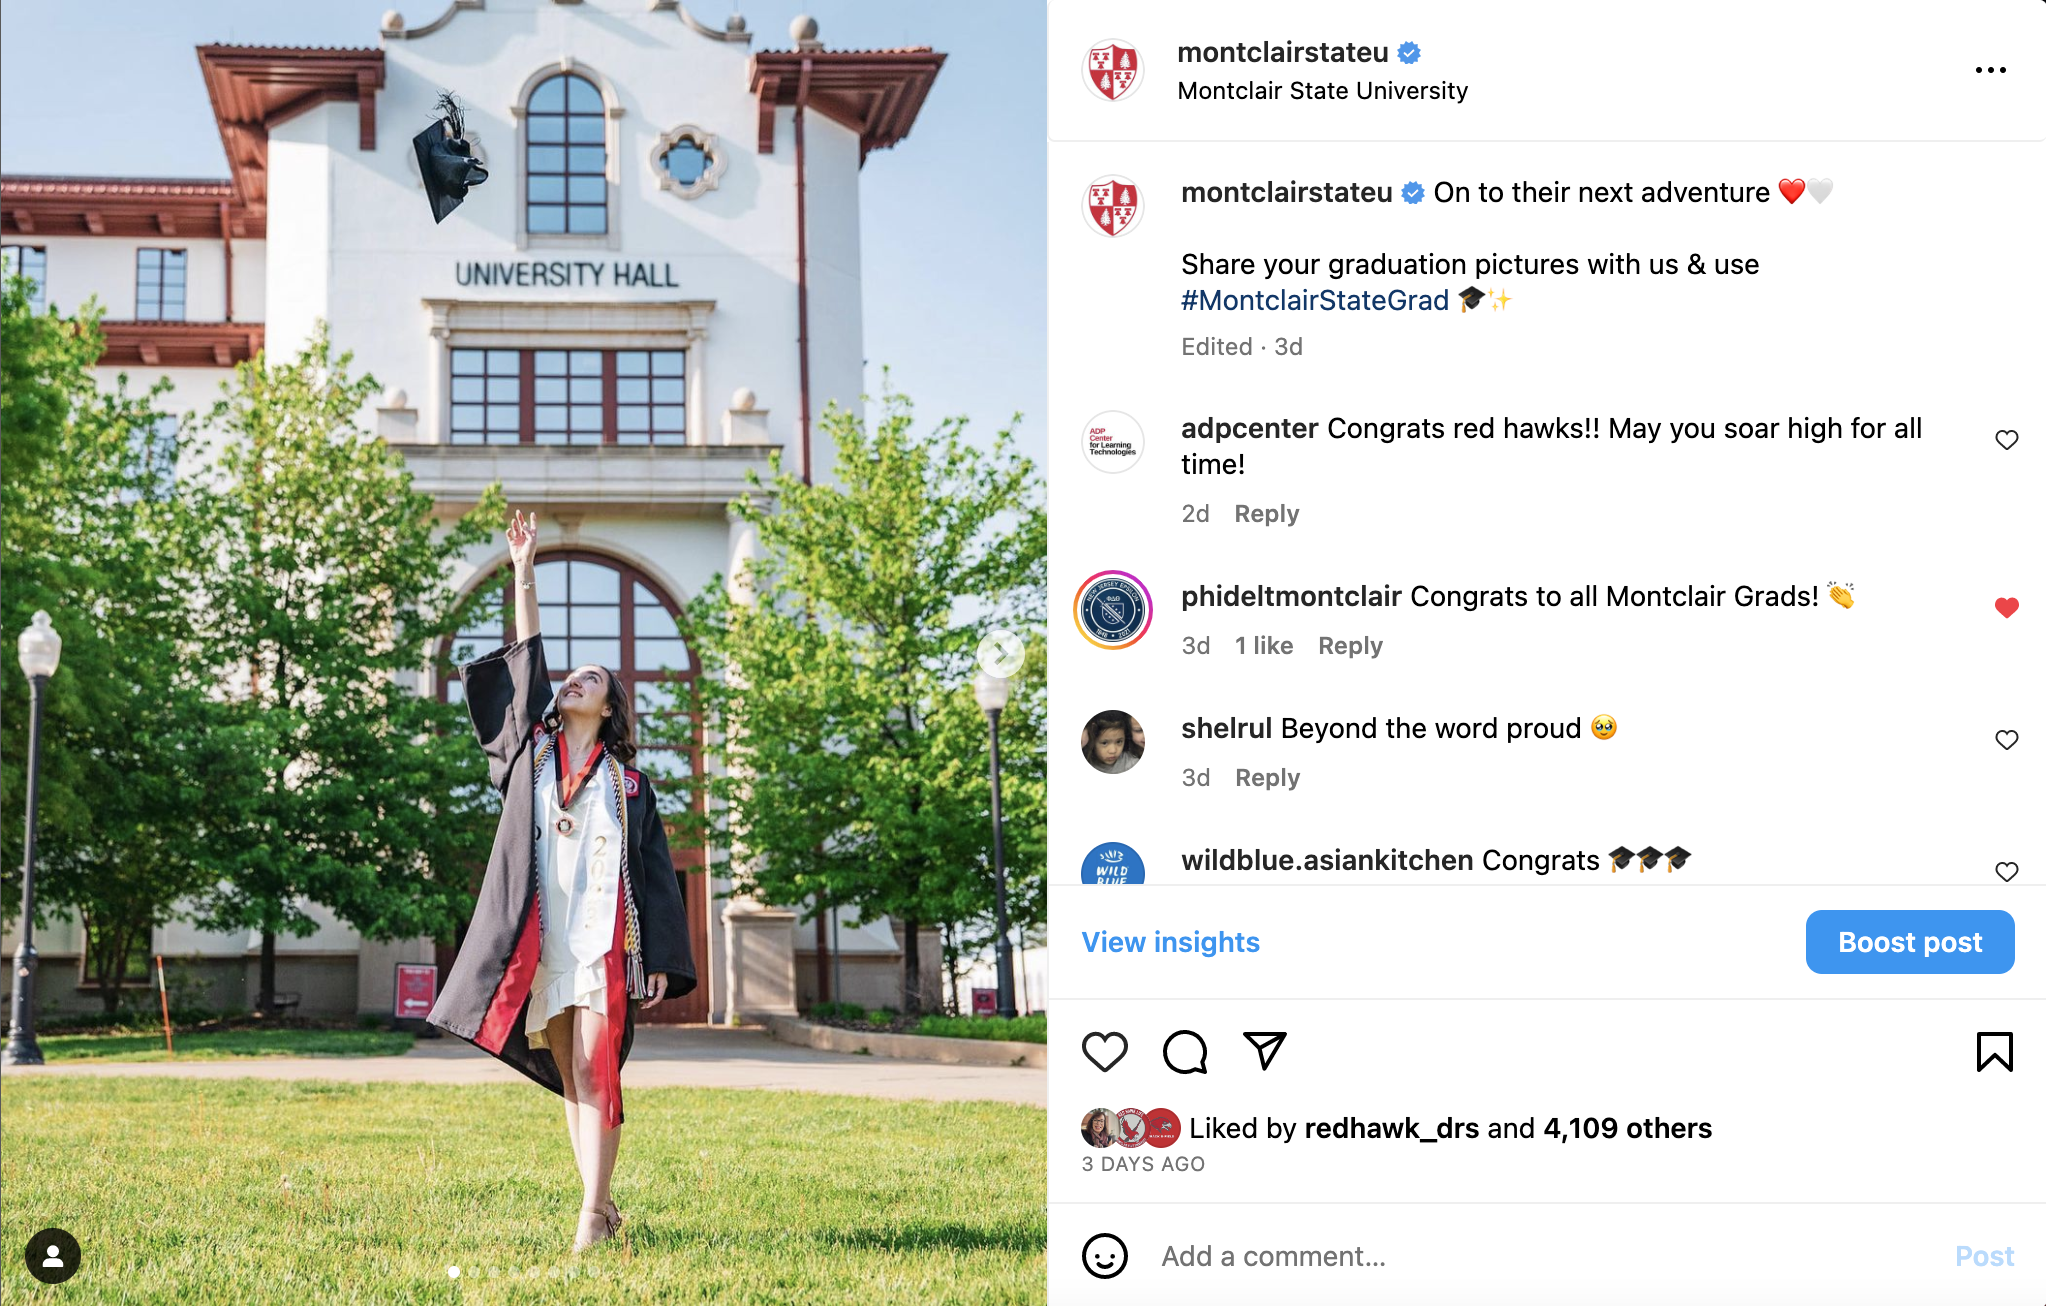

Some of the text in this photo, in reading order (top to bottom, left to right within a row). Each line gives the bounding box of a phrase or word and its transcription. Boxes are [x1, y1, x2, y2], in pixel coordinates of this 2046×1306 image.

[1179, 40, 1388, 63] montclairstateu
[1179, 81, 1468, 104] Montclair State University
[1183, 180, 1770, 203] montclairstateu On to their next adventure
[456, 261, 679, 288] UNIVERSITY HALL
[1182, 253, 1759, 279] Share your graduation pictures with us & use
[1181, 289, 1448, 311] #MontclairStateGrad
[1183, 337, 1302, 355] Edited 3d
[1182, 417, 1921, 443] adpcenter Congrats red hawks!! May you soar high for all
[1101, 441, 1132, 450] Learning
[1181, 453, 1244, 475] time!
[1183, 504, 1300, 527] 2d Reply
[1183, 584, 1818, 611] phideltmontclair Congrats to all Montclair Grads!
[1183, 635, 1383, 659] 3d 1 like Reply
[1182, 717, 1580, 743] shelrul Beyond the word proud
[1183, 768, 1300, 791] 3d Reply
[1097, 866, 1128, 876] WILD
[1182, 848, 1599, 875] wildblue.asiankitchen Congrats
[1082, 930, 1260, 958] View insights
[1840, 932, 1983, 957] Boost post
[1191, 1117, 1712, 1144] Liked by redhawk_drs and 4,109 others
[1082, 1156, 1204, 1172] 3 DAYS AGO
[1162, 1245, 1385, 1266] Add a comment...
[1957, 1246, 2014, 1267] Post
